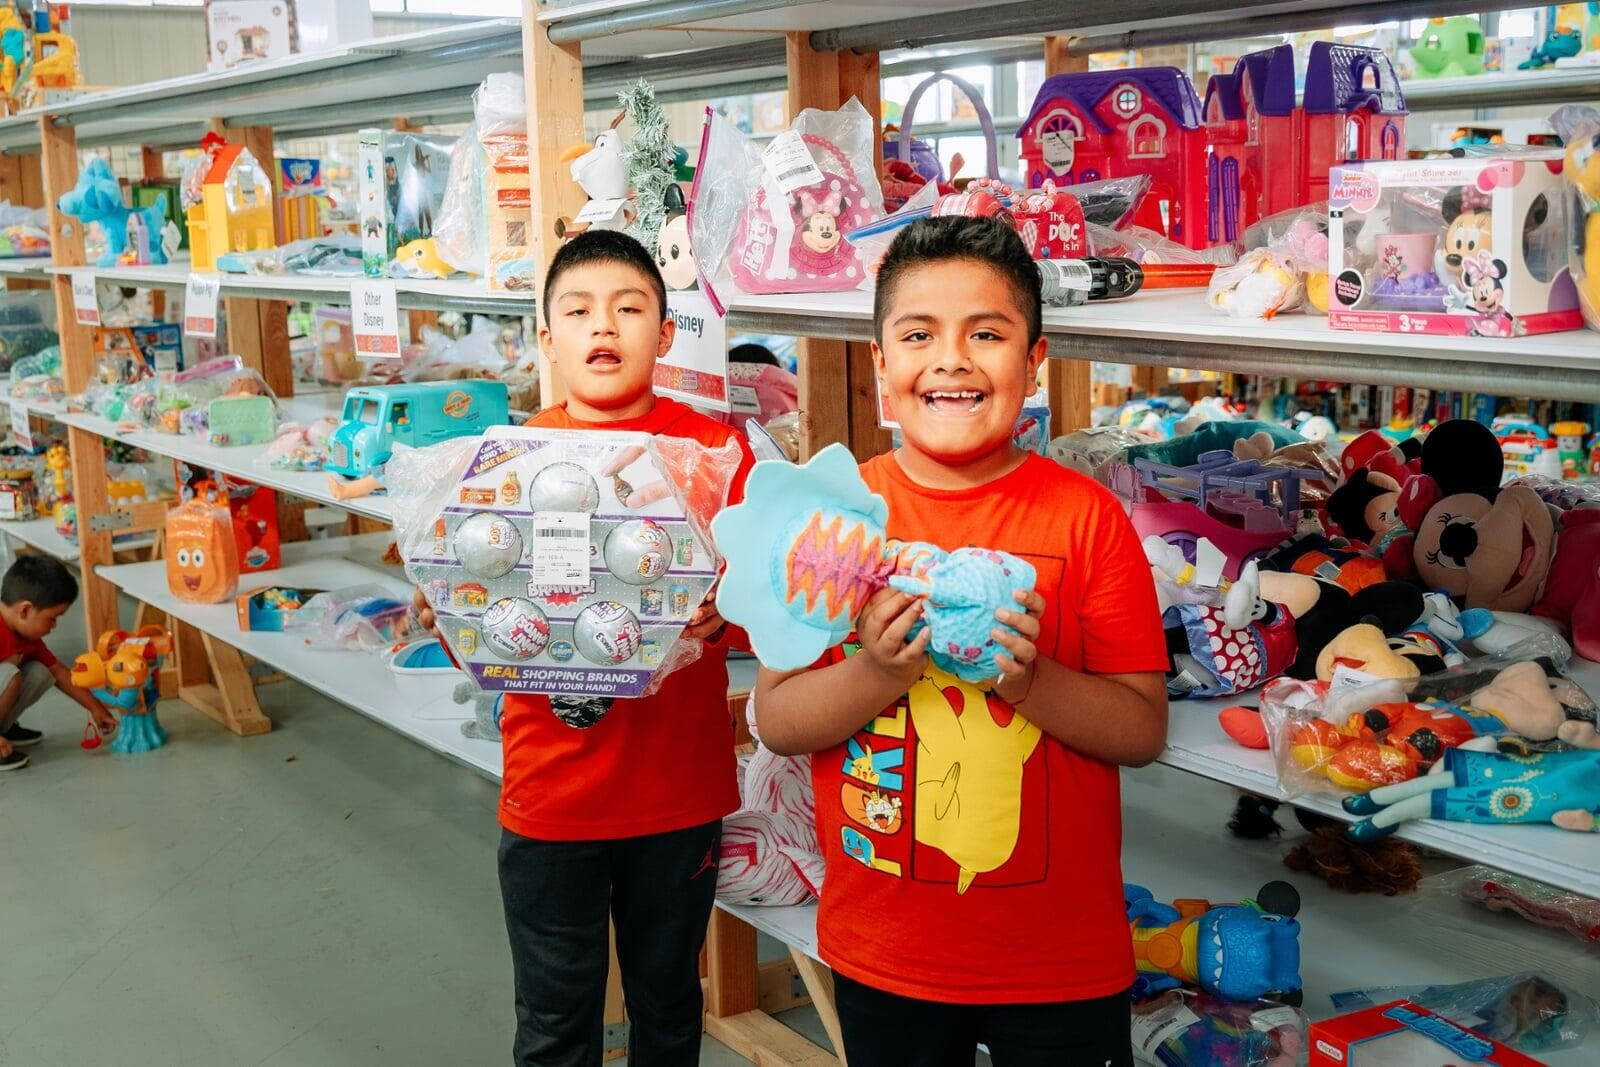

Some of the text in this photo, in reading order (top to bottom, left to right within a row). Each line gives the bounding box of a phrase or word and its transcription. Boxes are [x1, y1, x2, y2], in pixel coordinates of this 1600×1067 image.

[1049, 211, 1065, 222] The
[1048, 222, 1080, 242] DOC
[363, 291, 382, 306] Other
[363, 312, 385, 328] Disney
[1399, 314, 1411, 332] 3
[483, 665, 638, 684] REAL SHOPPING BRANDS
[504, 680, 617, 693] THAT FIT IN YOUR HAND!
